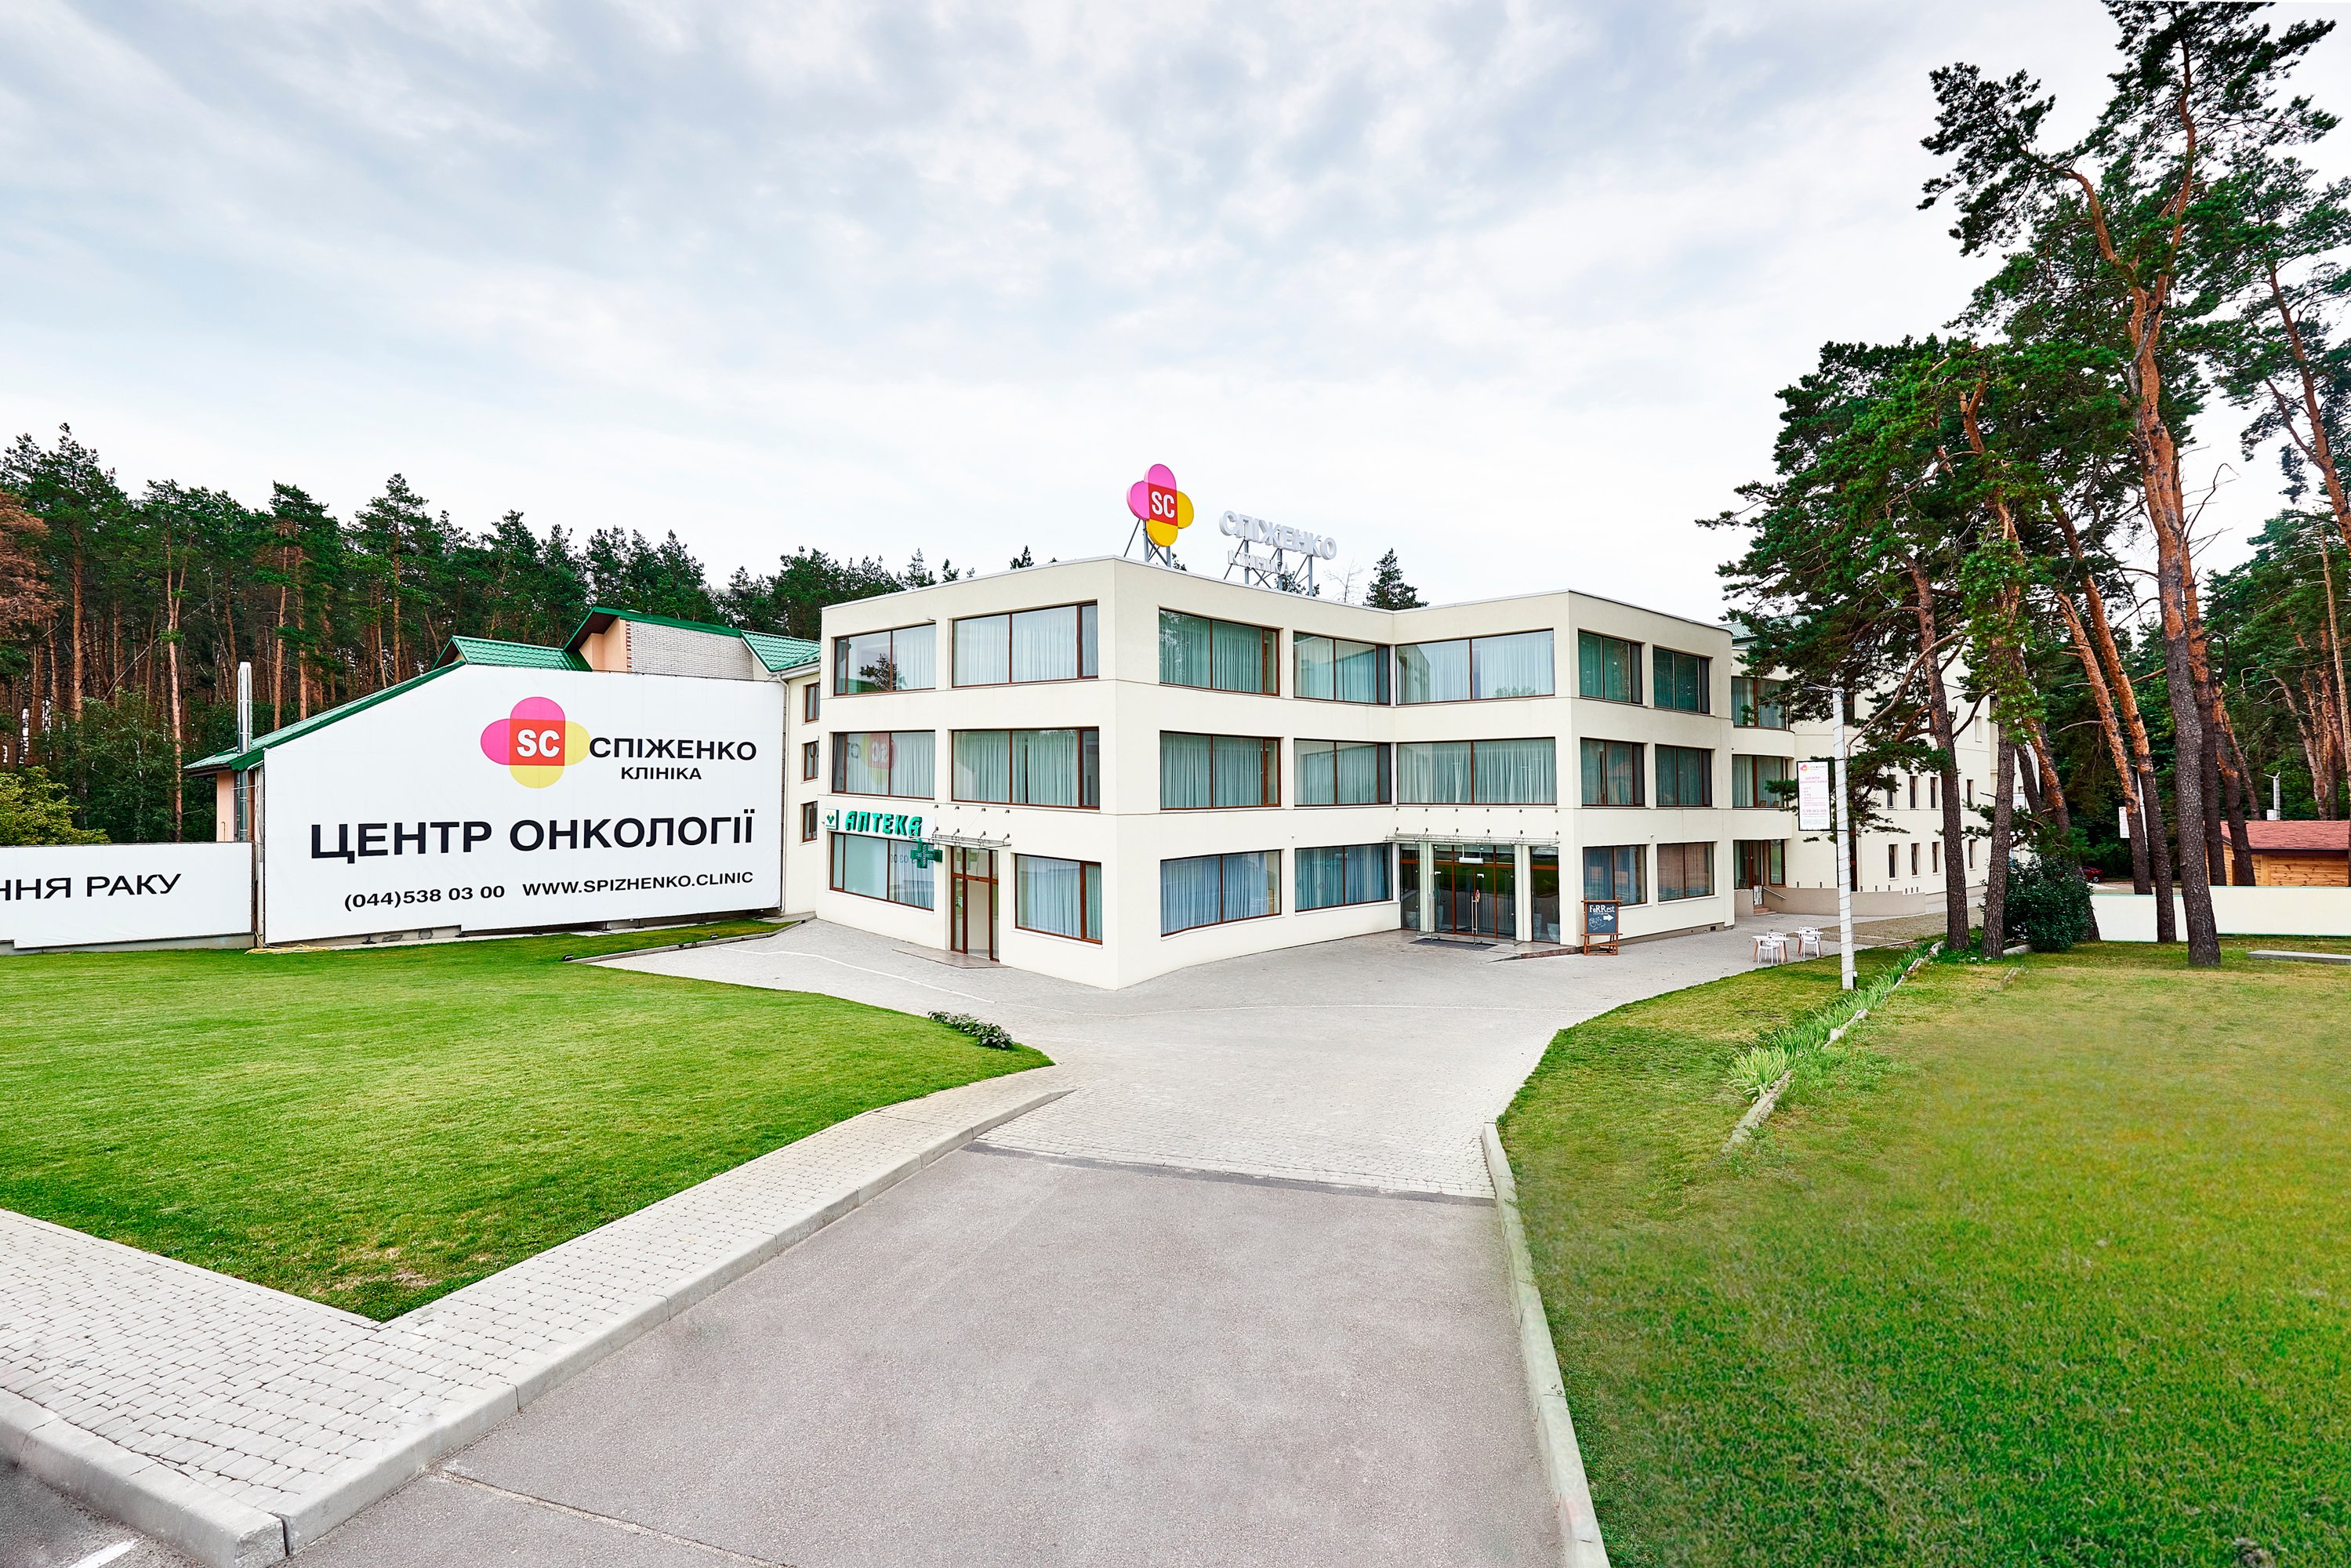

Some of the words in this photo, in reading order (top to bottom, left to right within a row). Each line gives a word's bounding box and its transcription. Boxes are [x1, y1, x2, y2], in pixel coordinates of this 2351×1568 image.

[1151, 491, 1175, 518] SC
[1219, 510, 1337, 561] СПІЖЕНКО
[516, 728, 561, 758] SC
[589, 737, 757, 761] СПІЖЕНКО
[621, 766, 702, 780] КЛІНІКА
[311, 821, 492, 864] ЦЕНТР
[510, 808, 755, 851] ОНКОЛОГІЇ
[845, 811, 923, 837] АПТЕКА
[86, 873, 182, 898] РАКУ
[344, 888, 441, 912] (044)538
[448, 887, 473, 901] 03
[480, 885, 505, 898] 00
[522, 871, 753, 896] WWW.SPIZHENKO.CLINIC
